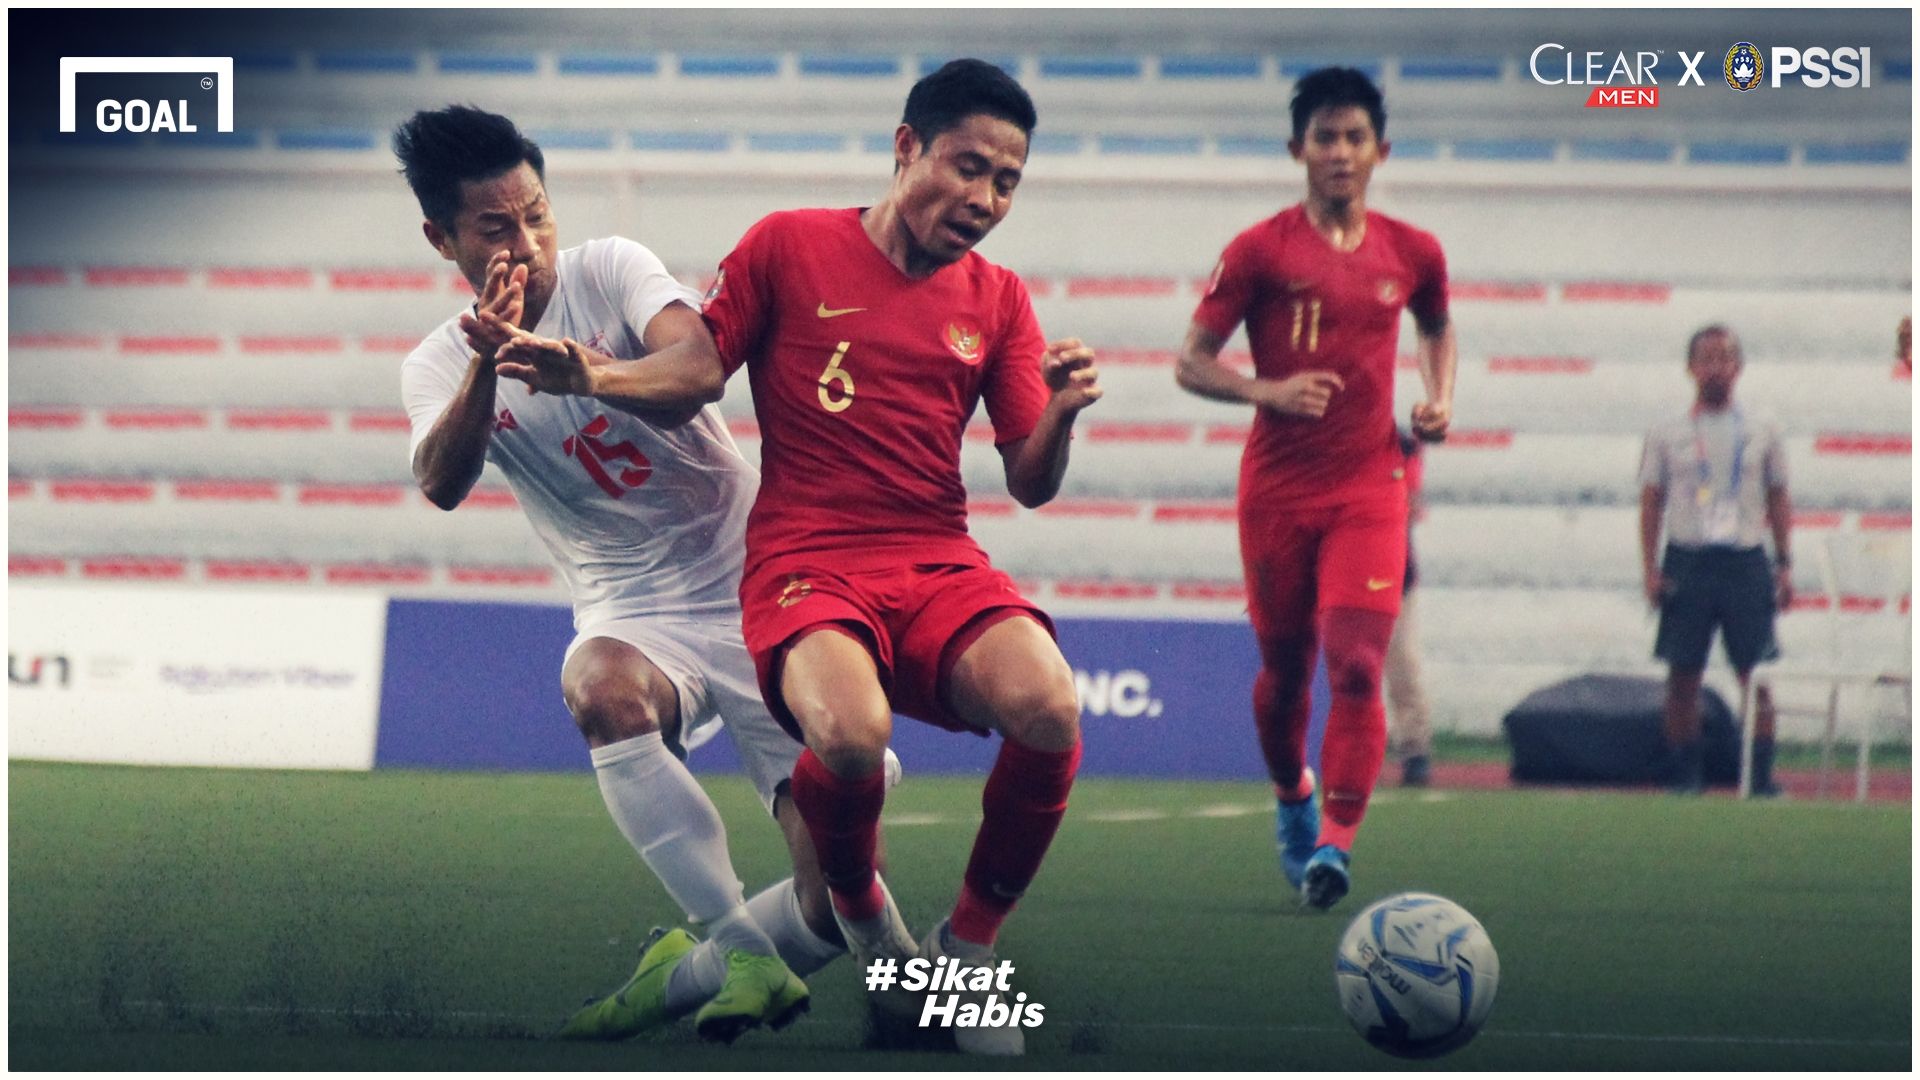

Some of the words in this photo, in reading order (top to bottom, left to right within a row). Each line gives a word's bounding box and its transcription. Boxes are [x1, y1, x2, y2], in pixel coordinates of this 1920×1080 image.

[1290, 299, 1322, 352] 11
[817, 341, 855, 412] 6
[562, 413, 654, 500] 15
